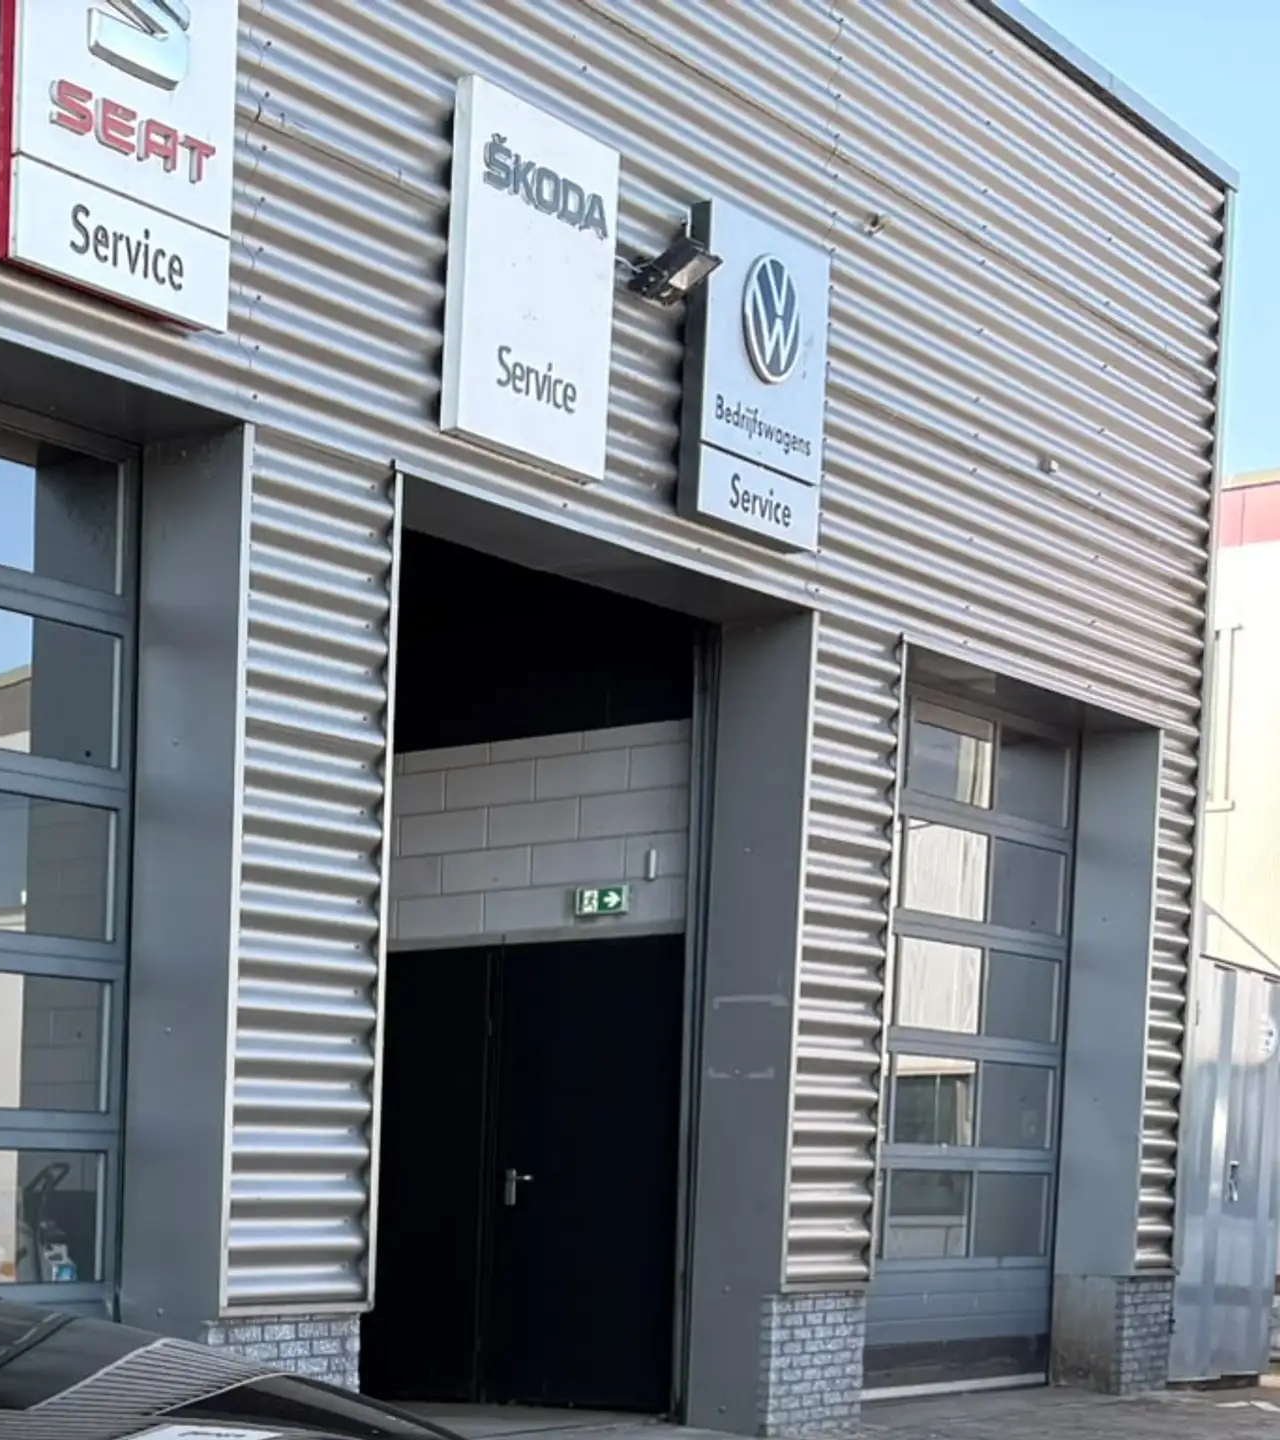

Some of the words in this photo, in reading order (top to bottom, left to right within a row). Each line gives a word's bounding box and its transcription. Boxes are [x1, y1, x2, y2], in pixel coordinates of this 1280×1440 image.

[49, 79, 216, 184] SEAT
[483, 132, 609, 241] ŠKODA
[69, 203, 184, 291] Service
[496, 345, 577, 414] Service
[715, 393, 812, 457] Bedrijfswagens
[729, 474, 792, 527] Service
